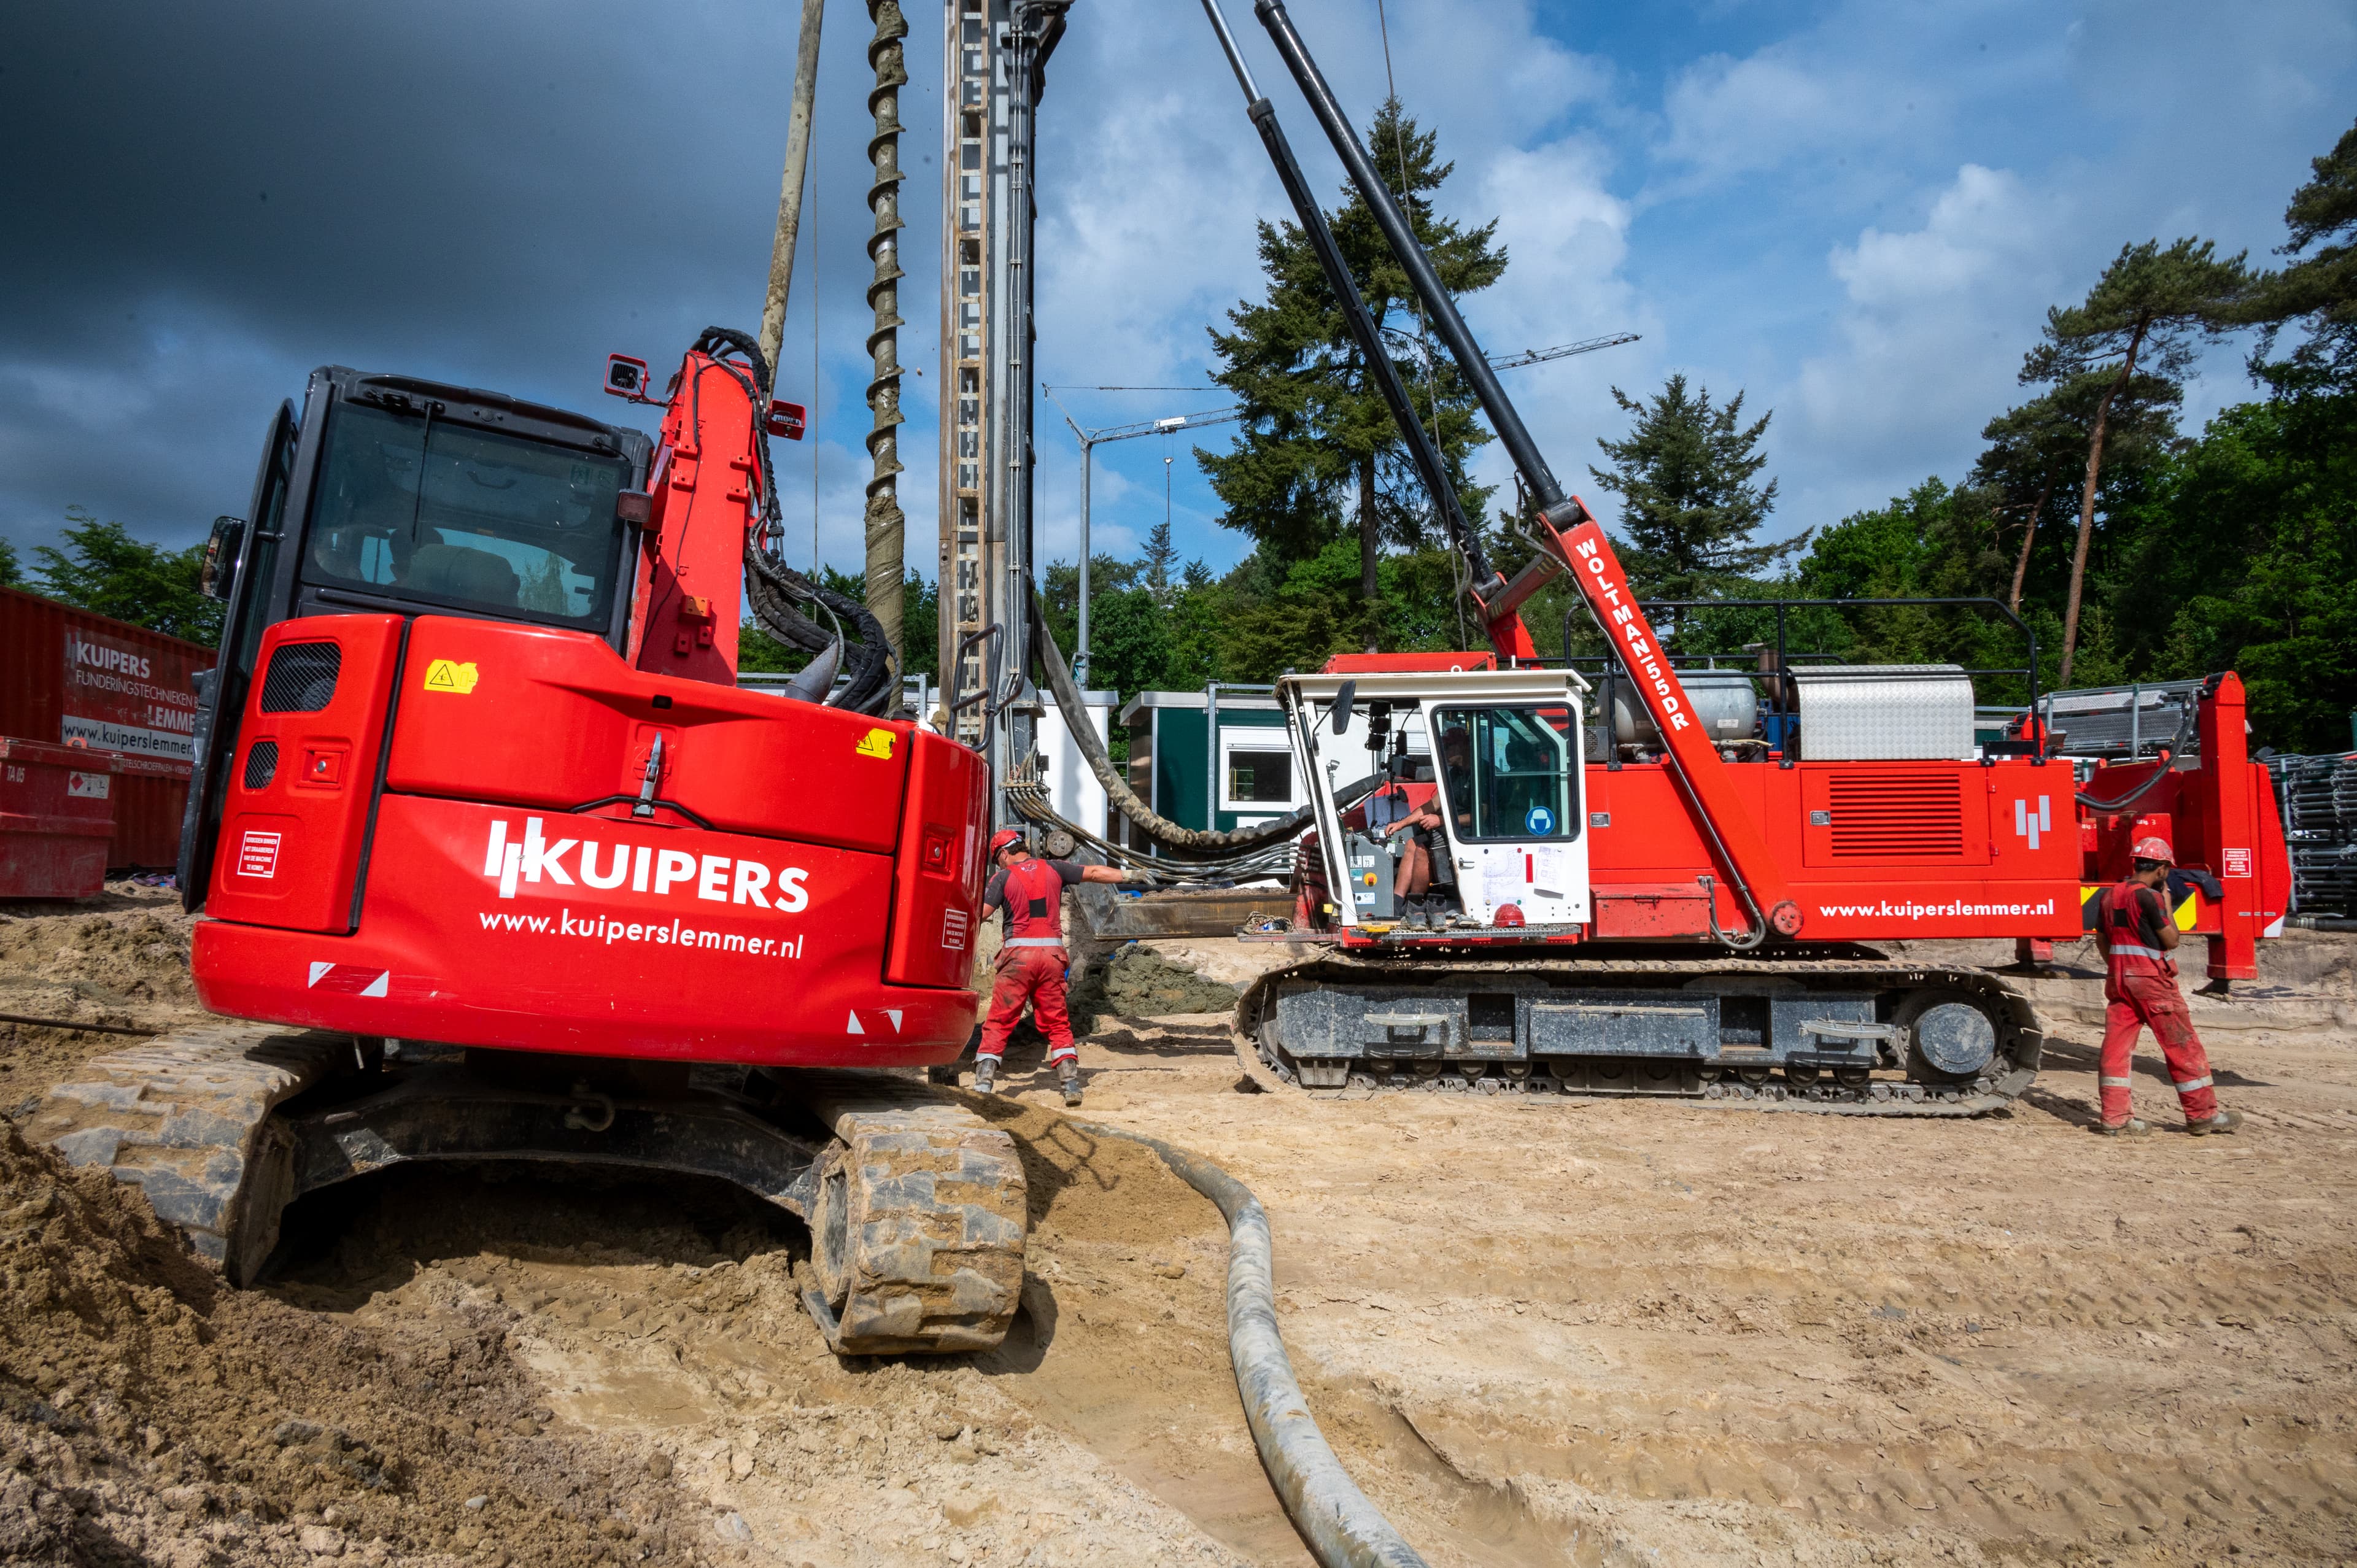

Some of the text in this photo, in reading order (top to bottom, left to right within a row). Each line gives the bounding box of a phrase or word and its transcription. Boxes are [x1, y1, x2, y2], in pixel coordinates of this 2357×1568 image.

[77, 641, 150, 679] KUIPERS
[76, 670, 192, 707] FUNDERINGSTECHNIEKEN
[525, 836, 809, 913] KUIPERS
[1819, 899, 2054, 920] www.kuiperslemmer.nl
[479, 908, 803, 959] www.kuiperslemmer.nl
